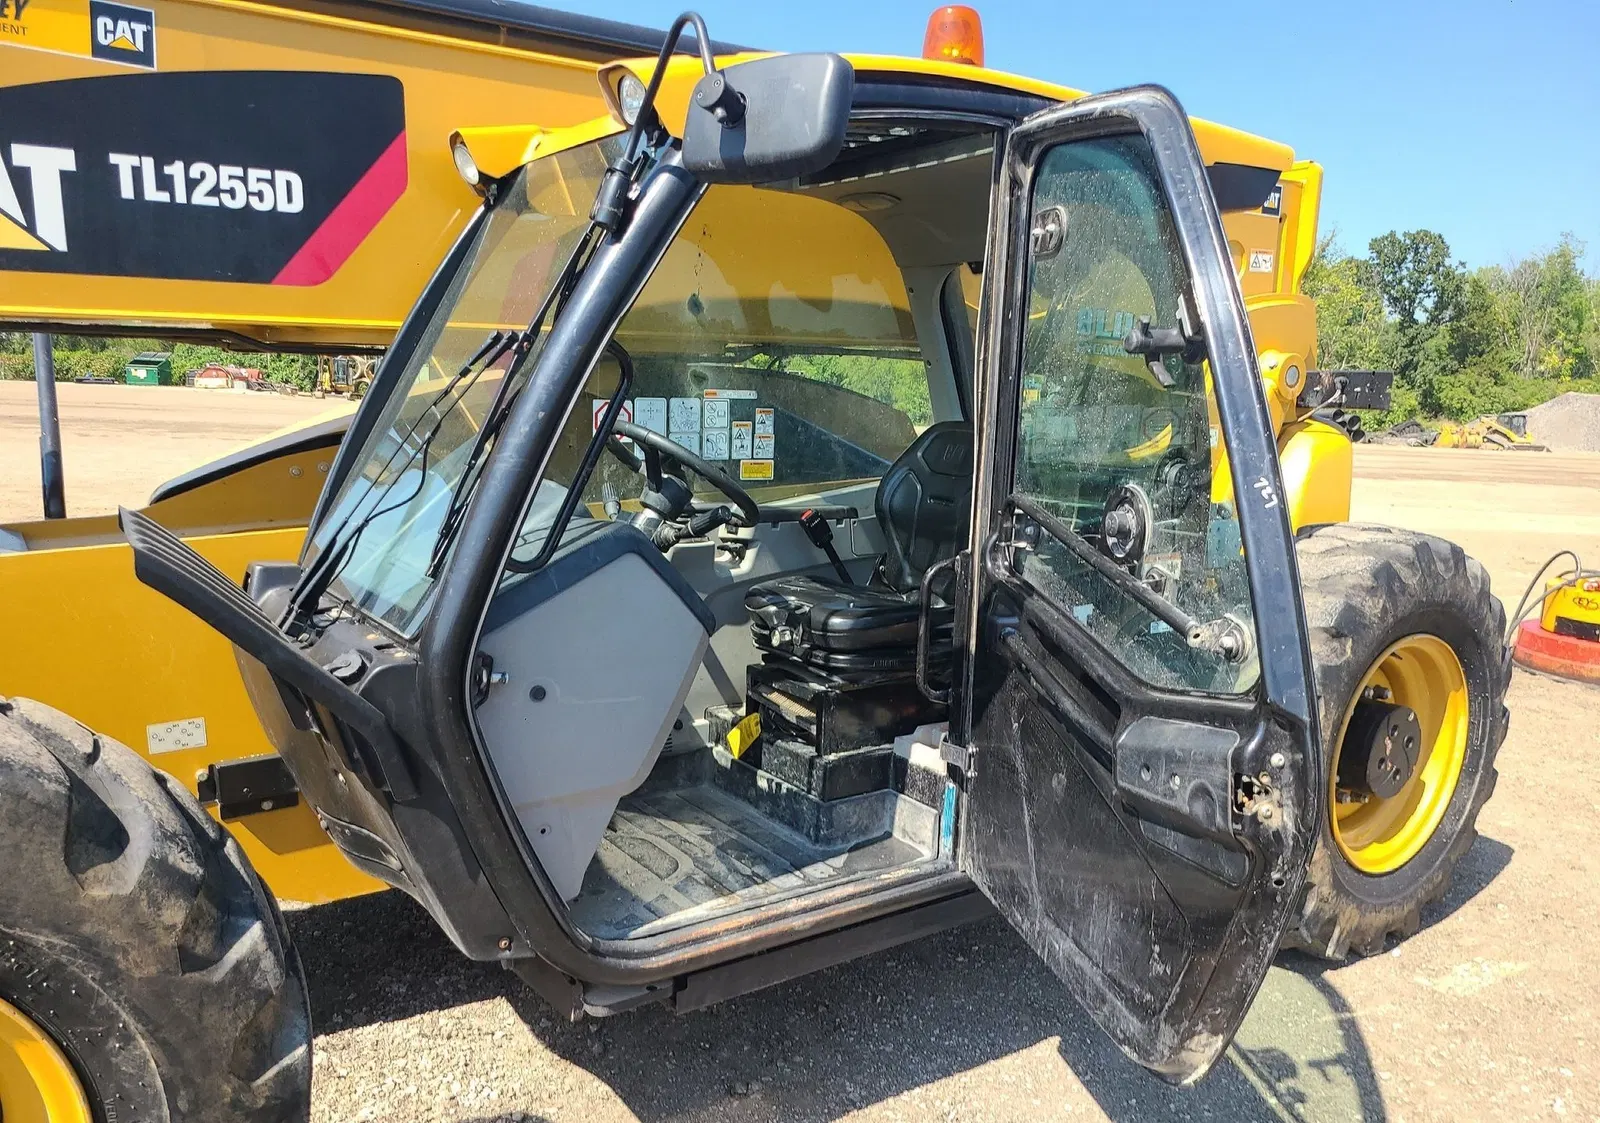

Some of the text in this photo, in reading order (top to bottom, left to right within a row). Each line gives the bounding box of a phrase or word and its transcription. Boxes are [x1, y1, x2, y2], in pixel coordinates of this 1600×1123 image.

[0, 22, 28, 36] ENT
[97, 16, 147, 52] CAT
[109, 152, 304, 214] TL1255D
